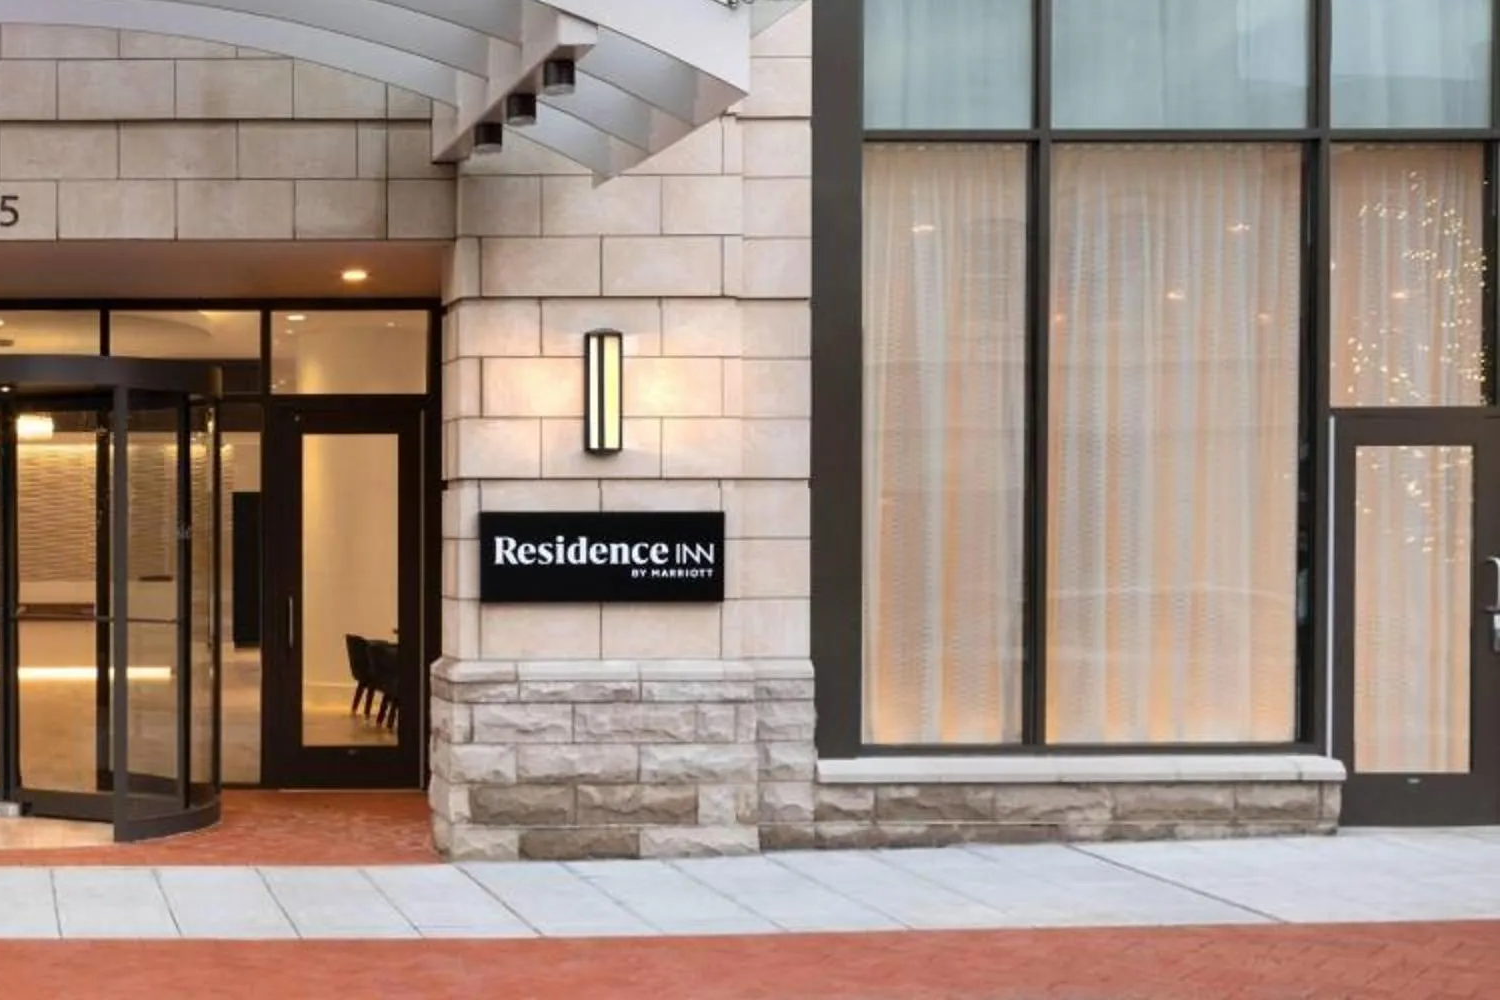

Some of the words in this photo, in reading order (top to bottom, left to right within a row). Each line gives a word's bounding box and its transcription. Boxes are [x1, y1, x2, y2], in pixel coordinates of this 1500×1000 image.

[493, 535, 669, 565] Residence
[675, 543, 715, 565] INN
[631, 568, 647, 579] BY
[651, 568, 714, 579] MARRIOTT
